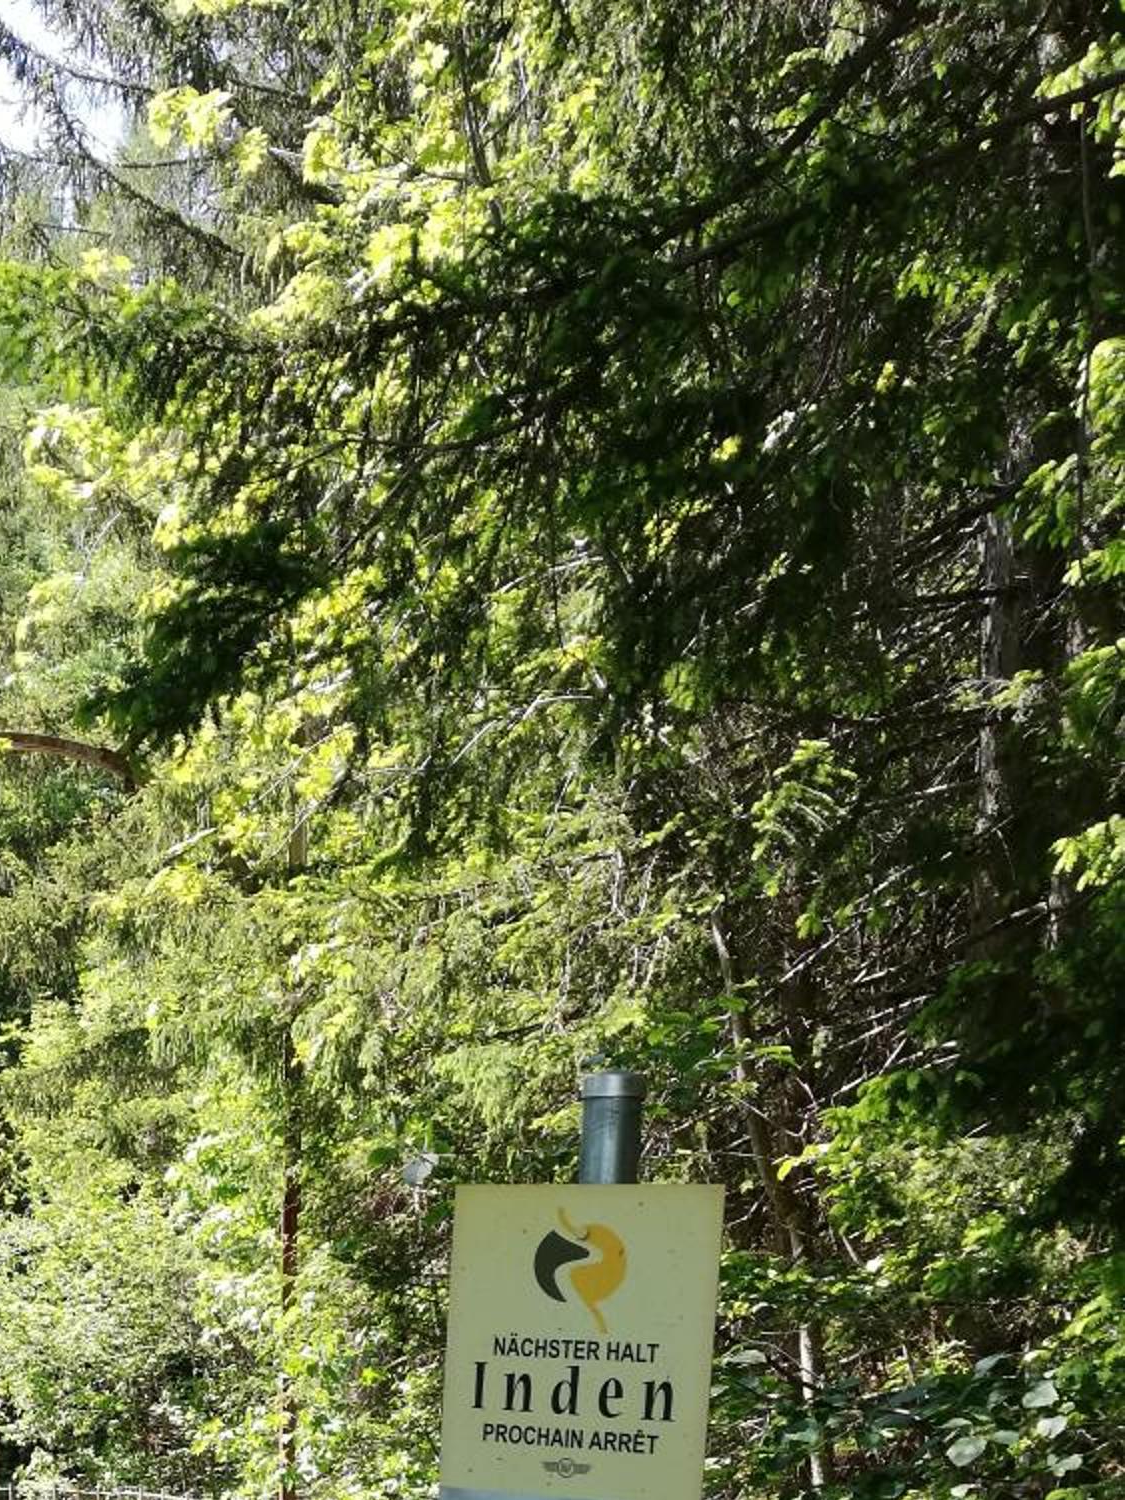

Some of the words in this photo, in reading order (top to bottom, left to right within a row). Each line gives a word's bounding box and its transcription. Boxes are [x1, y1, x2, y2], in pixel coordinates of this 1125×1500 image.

[493, 1332, 600, 1361] NÄCHSTER
[606, 1341, 660, 1364] HALT
[471, 1361, 676, 1423] Inden
[481, 1423, 584, 1449] PROCHAIN
[588, 1430, 660, 1455] ARRÊT
